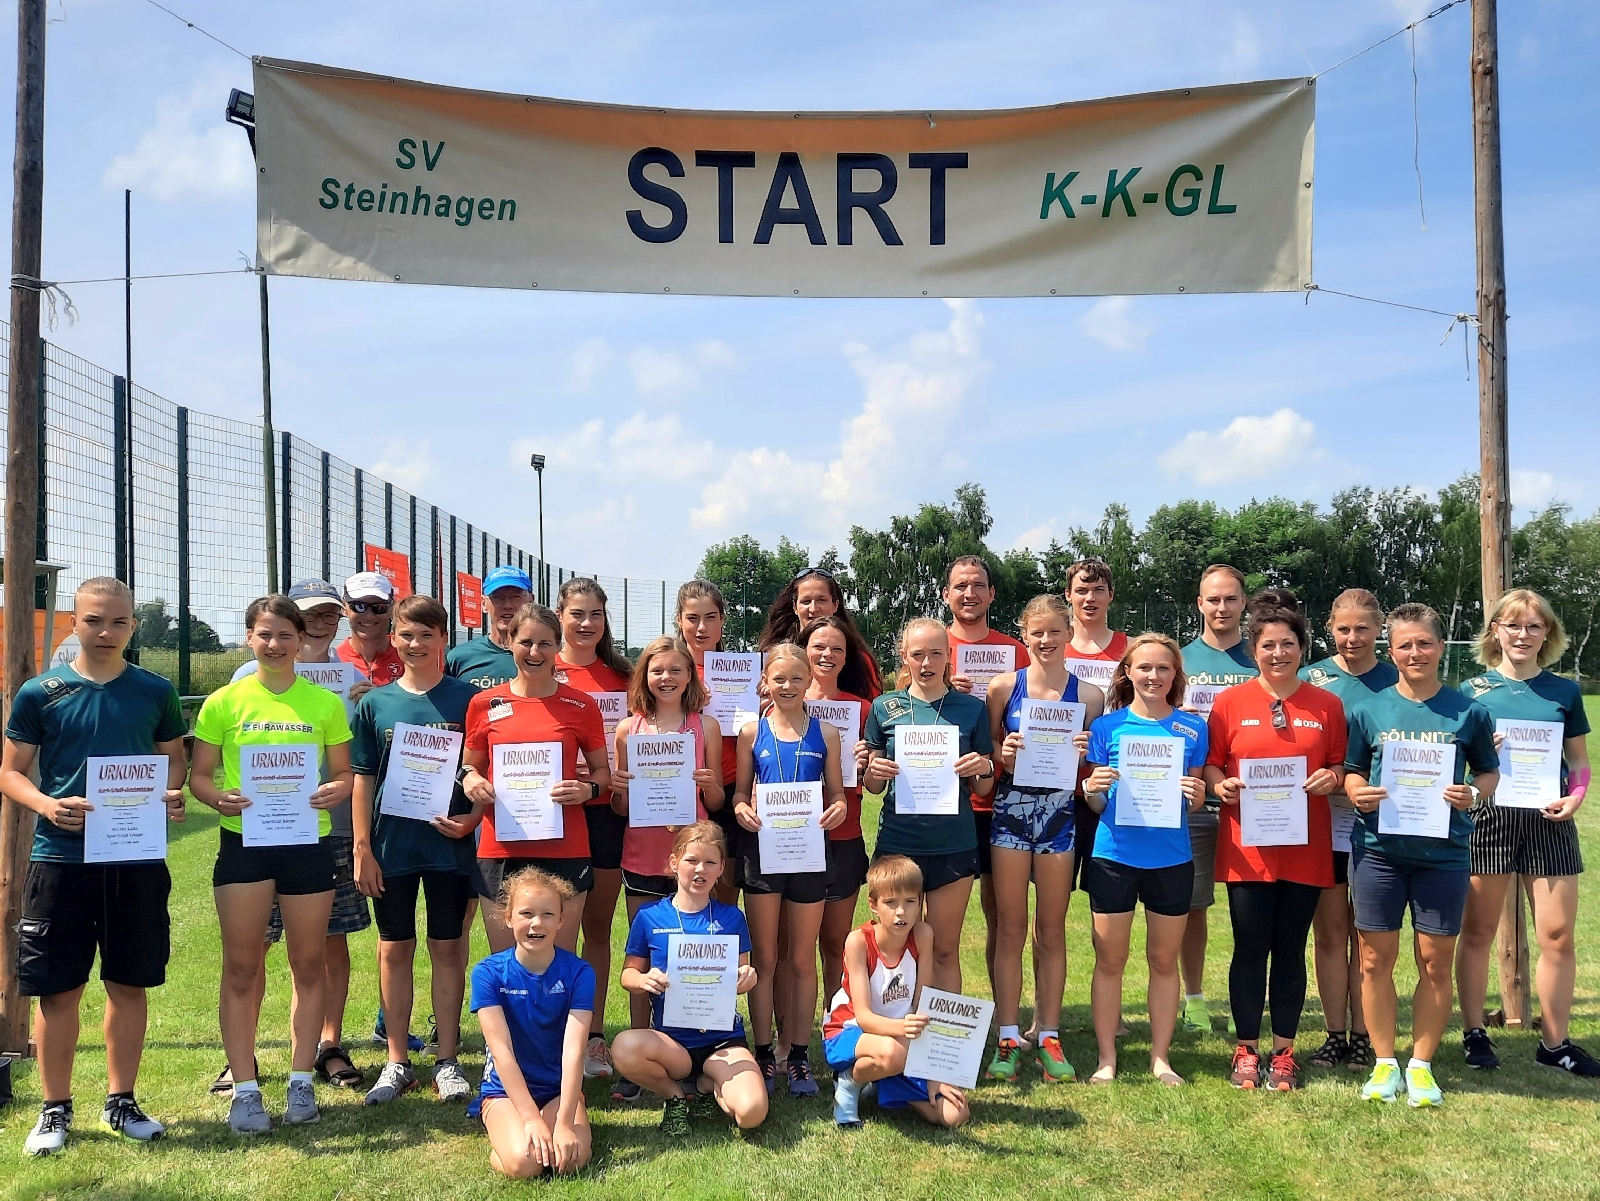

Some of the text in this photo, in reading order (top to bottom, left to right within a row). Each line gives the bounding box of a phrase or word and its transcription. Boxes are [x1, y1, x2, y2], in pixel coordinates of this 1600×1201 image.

[395, 138, 445, 172] SV
[625, 146, 968, 247] START
[1040, 164, 1238, 220] K-K-GL
[319, 178, 517, 227] Steinhagen
[711, 658, 752, 672] URKUNDE
[964, 650, 1007, 665] URKUNDE
[1029, 705, 1075, 723] URKUNDE
[252, 723, 313, 734] EURAWASSER
[1302, 720, 1324, 731] OSPA
[403, 730, 453, 752] URKUNDE
[904, 731, 949, 746] URKUNDE
[1505, 727, 1553, 743] URKUNDE
[637, 740, 685, 756] URKUNDE
[1126, 742, 1174, 758] URKUNDE
[1392, 747, 1444, 765] URKUNDE
[250, 751, 306, 768] URKUNDE
[502, 749, 551, 766] URKUNDE
[98, 763, 157, 781] URKUNDE
[1248, 763, 1296, 779] URKUNDE
[765, 789, 813, 806] URKUNDE
[677, 942, 729, 960] URKUNDE
[928, 996, 982, 1019] URKUNDE
